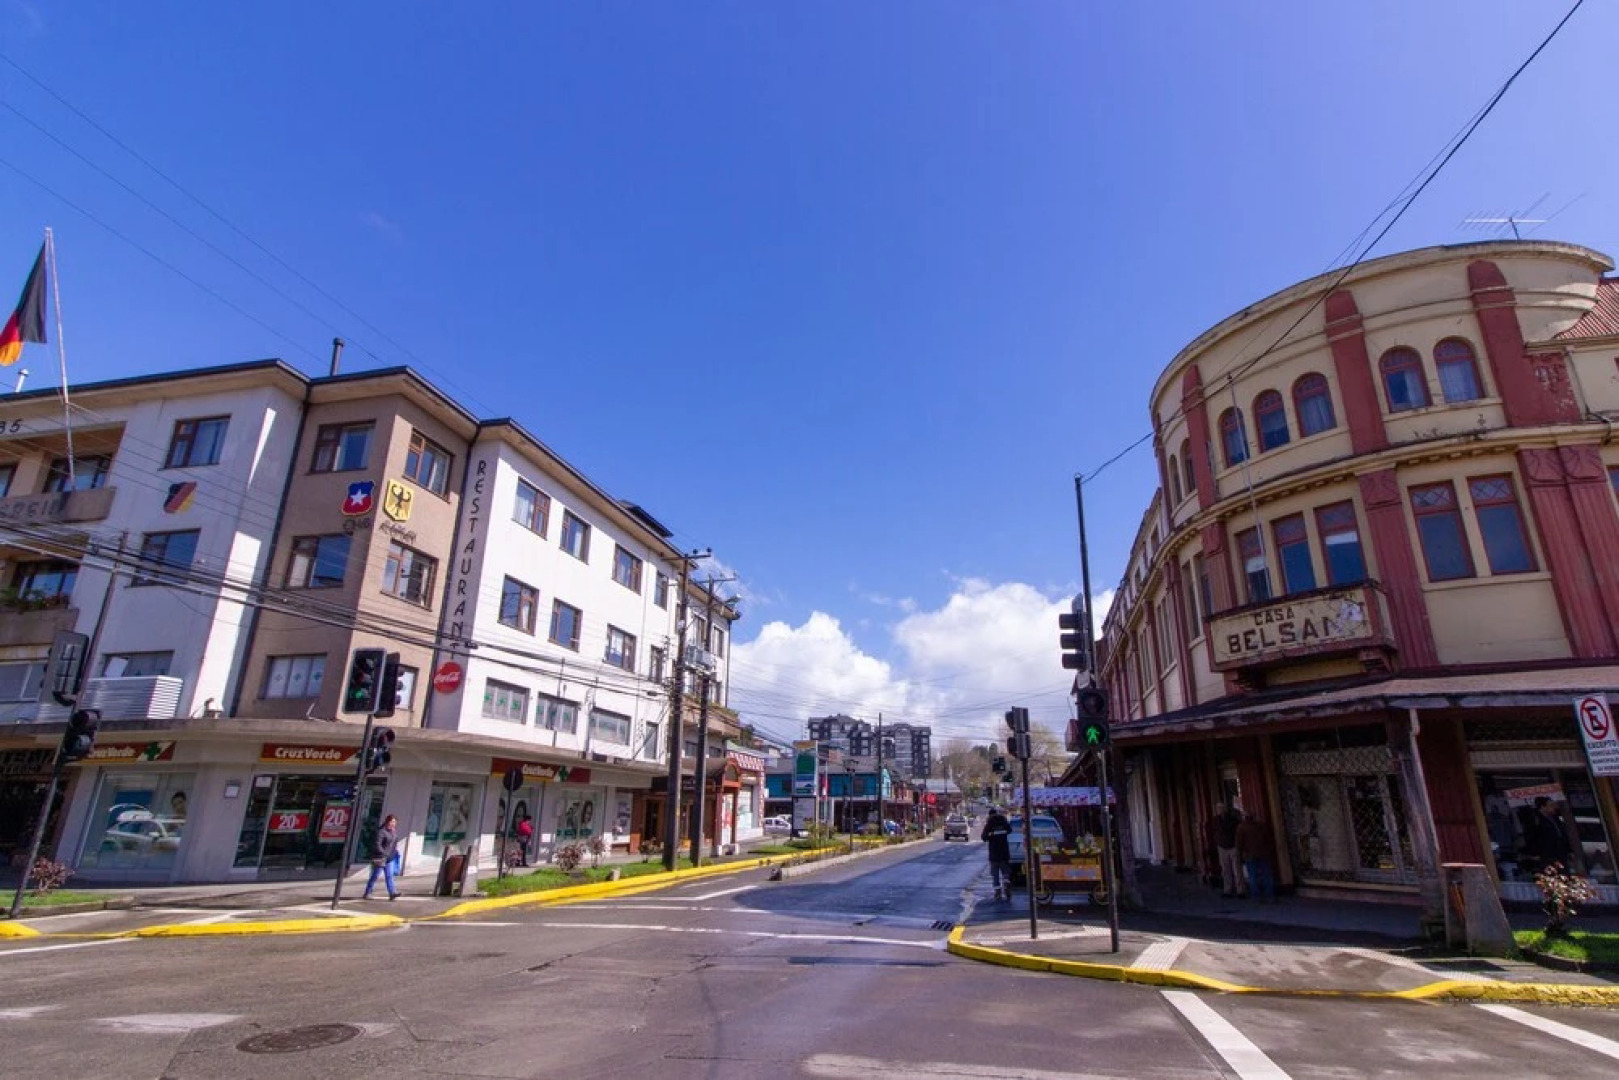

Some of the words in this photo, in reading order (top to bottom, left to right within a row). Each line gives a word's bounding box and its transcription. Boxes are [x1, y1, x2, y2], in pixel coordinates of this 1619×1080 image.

[450, 459, 487, 660] RESTAURANT
[1254, 607, 1294, 626] CASA
[274, 747, 304, 759] Cruz
[305, 748, 342, 760] Verde
